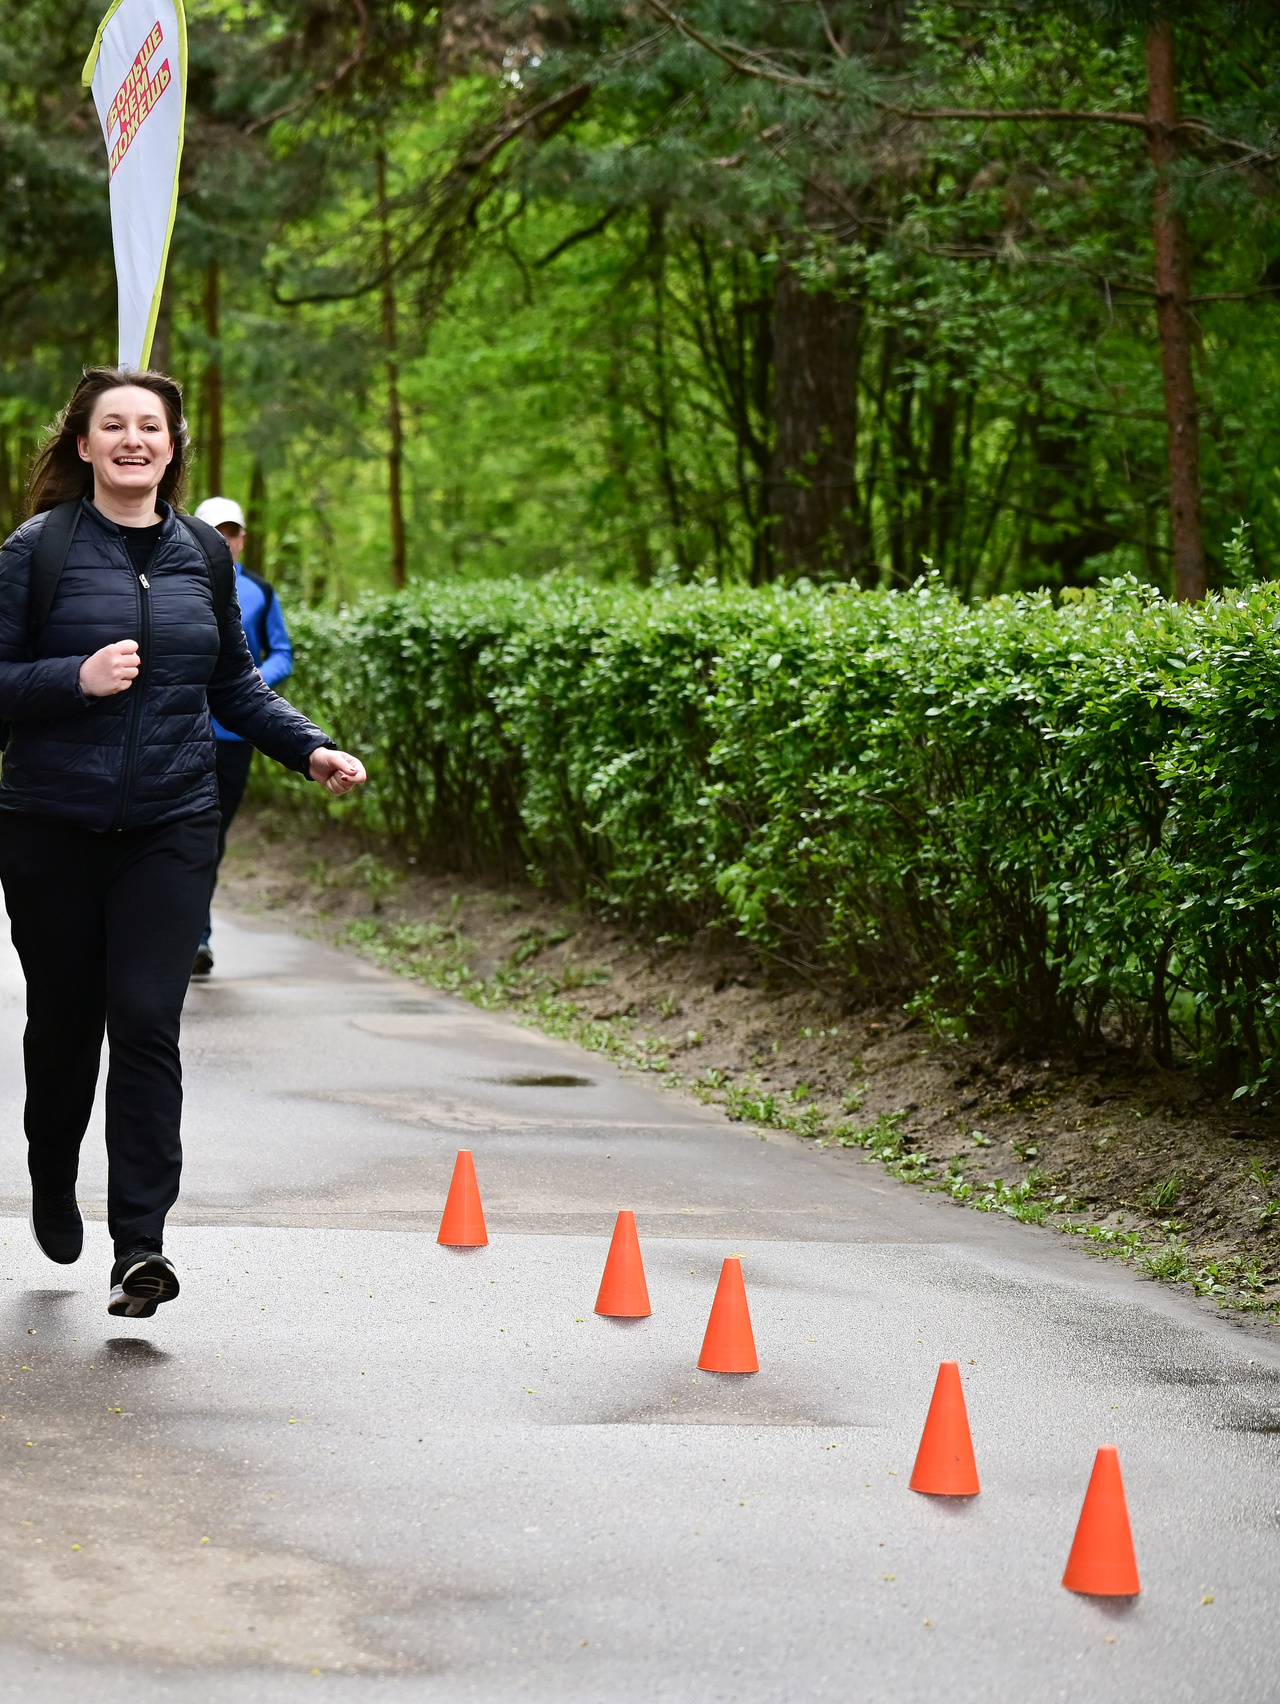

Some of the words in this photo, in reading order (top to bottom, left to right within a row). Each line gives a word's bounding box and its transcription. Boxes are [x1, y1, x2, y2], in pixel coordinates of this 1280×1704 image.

[108, 24, 163, 130] БОЛЬШЕ
[109, 67, 171, 178] МОЖЕШЬ
[120, 70, 150, 123] ЧЕМ
